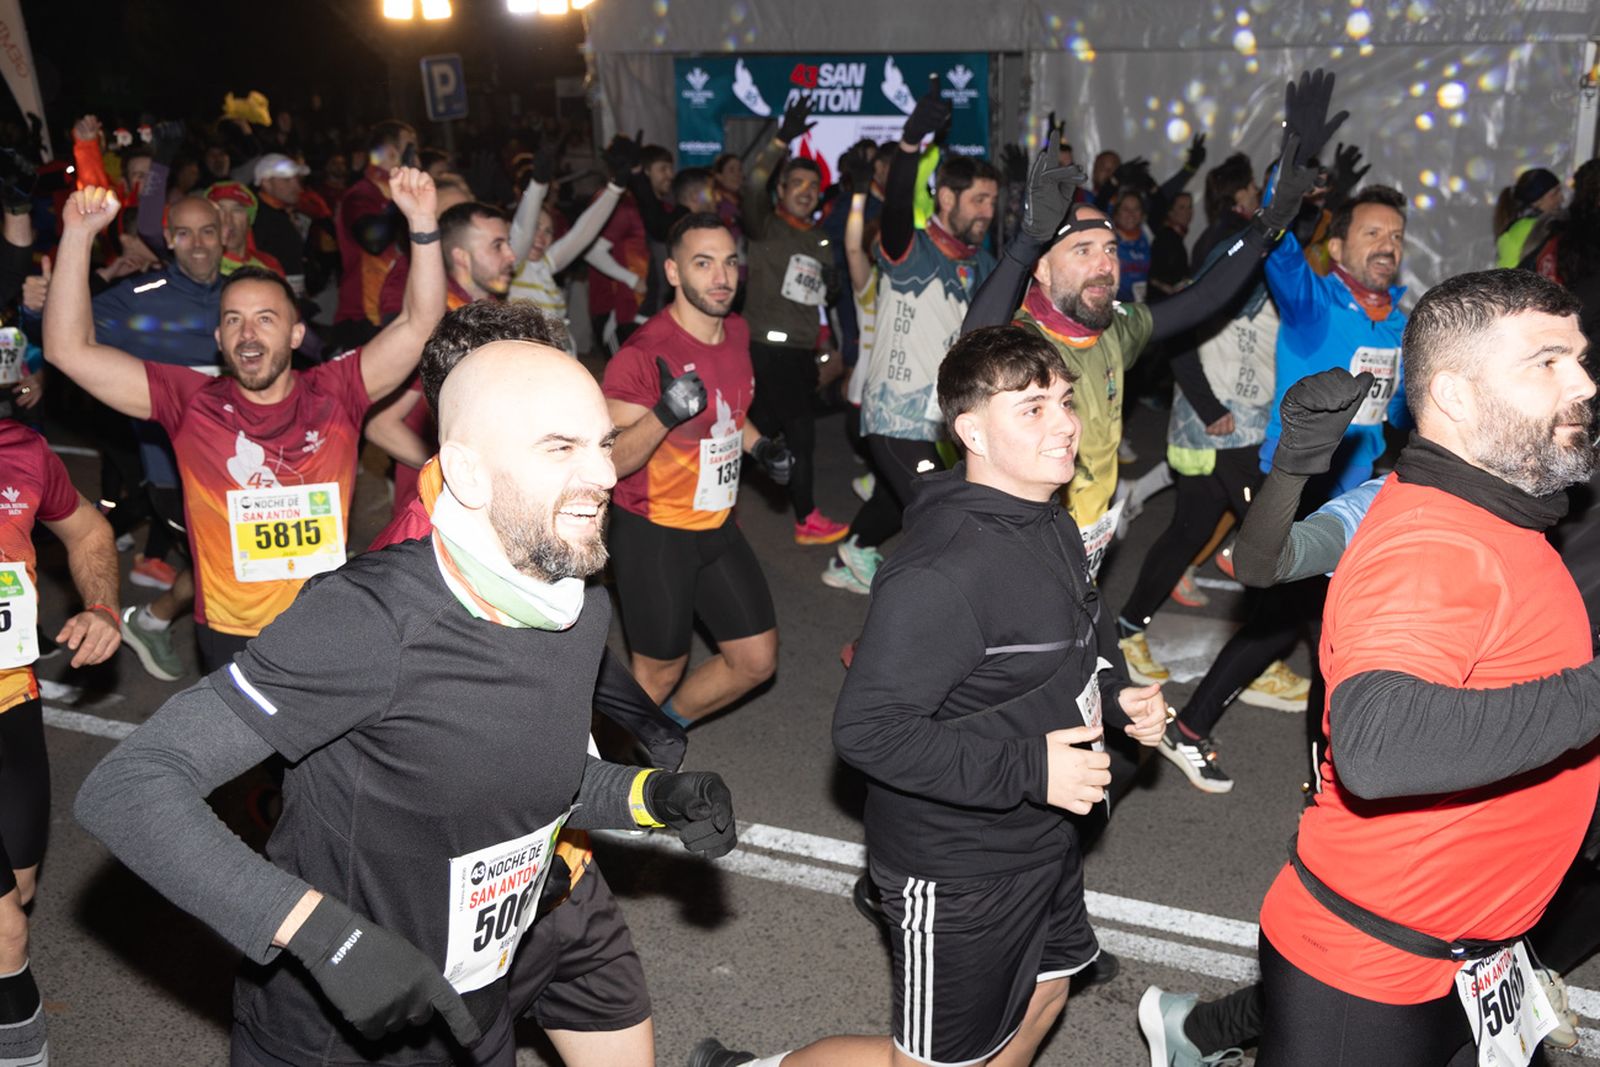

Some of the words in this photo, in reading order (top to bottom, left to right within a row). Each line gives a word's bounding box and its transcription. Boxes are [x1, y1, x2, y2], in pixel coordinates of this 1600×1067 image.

[790, 63, 818, 88] 43
[818, 62, 866, 88] SAN
[431, 64, 457, 113] P
[894, 317, 911, 334] GO
[889, 349, 906, 366] PO
[888, 365, 912, 382] DER
[254, 498, 285, 509] NOCHE
[288, 497, 299, 507] DE
[243, 511, 264, 522] SAN
[255, 519, 321, 550] 5815
[487, 851, 527, 881] NOCHE
[528, 843, 544, 862] DE
[470, 886, 496, 909] SAN
[498, 862, 540, 897] ANTÓN
[331, 928, 363, 965] KIPRUN
[1472, 972, 1491, 998] SAN
